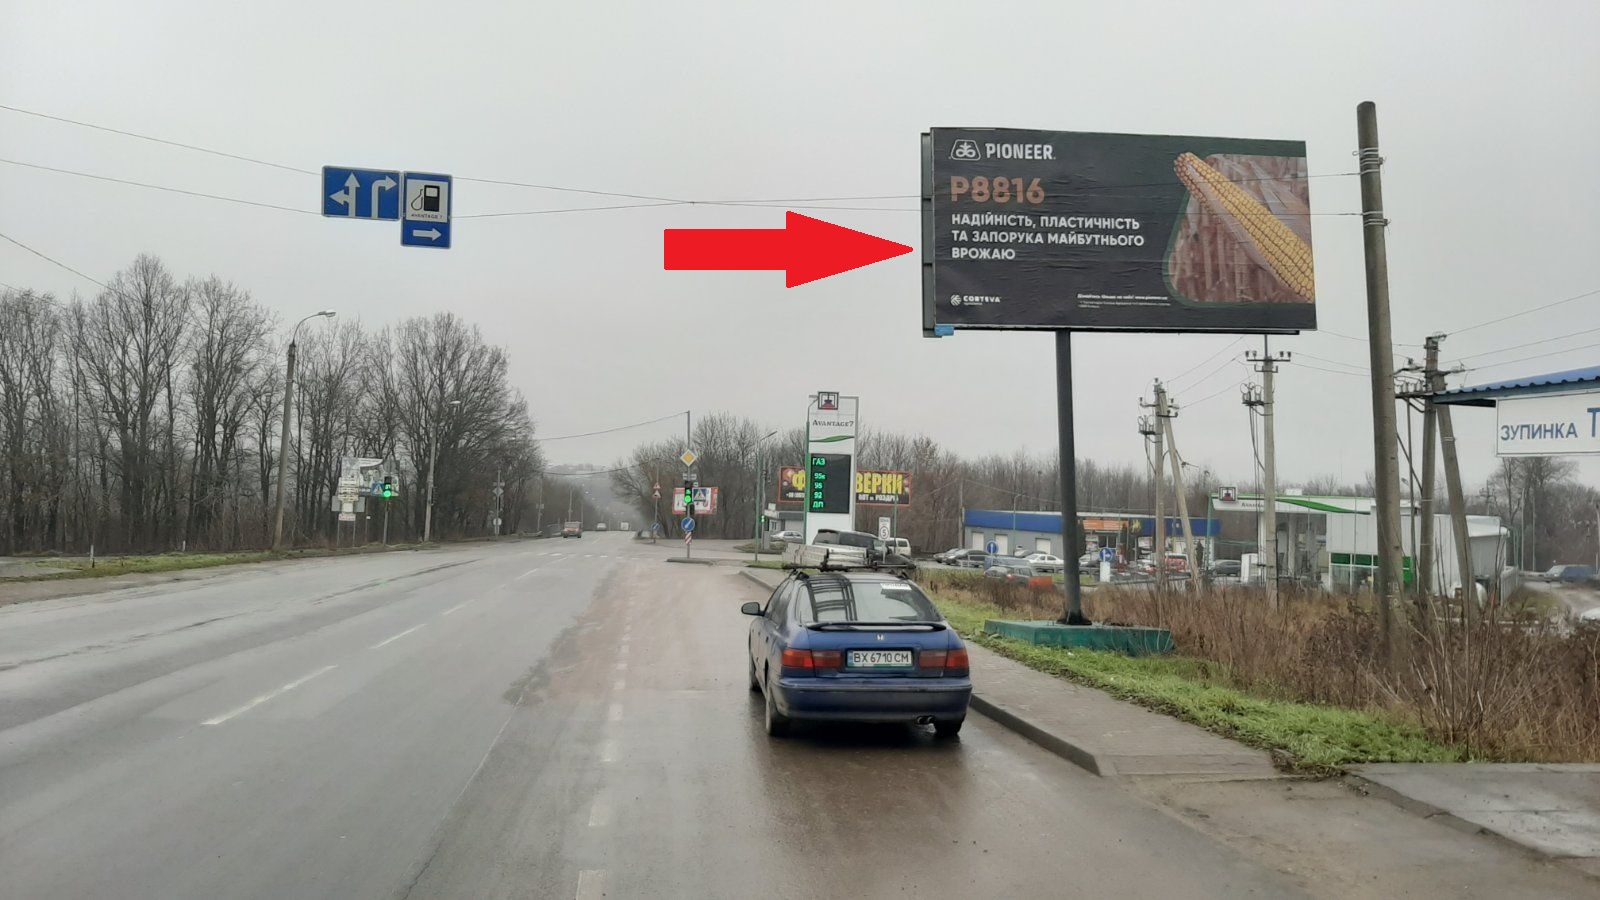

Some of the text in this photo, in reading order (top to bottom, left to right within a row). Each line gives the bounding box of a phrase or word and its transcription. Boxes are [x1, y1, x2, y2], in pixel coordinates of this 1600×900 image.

[985, 143, 1053, 160] PIONEER
[950, 176, 1045, 204] P8816
[951, 212, 1140, 230] НАДІЙНІСТЬ, ПЛАСТИЧНІСТЬ
[952, 230, 1145, 246] ТА ЗАПОРУКА МАЙБУТНЬОГО
[952, 248, 1016, 260] ВРОЖАЮ
[1500, 422, 1578, 440] ЗУПИНКА
[812, 457, 826, 466] ГАЗ
[854, 652, 909, 662] BX 6710 CM
